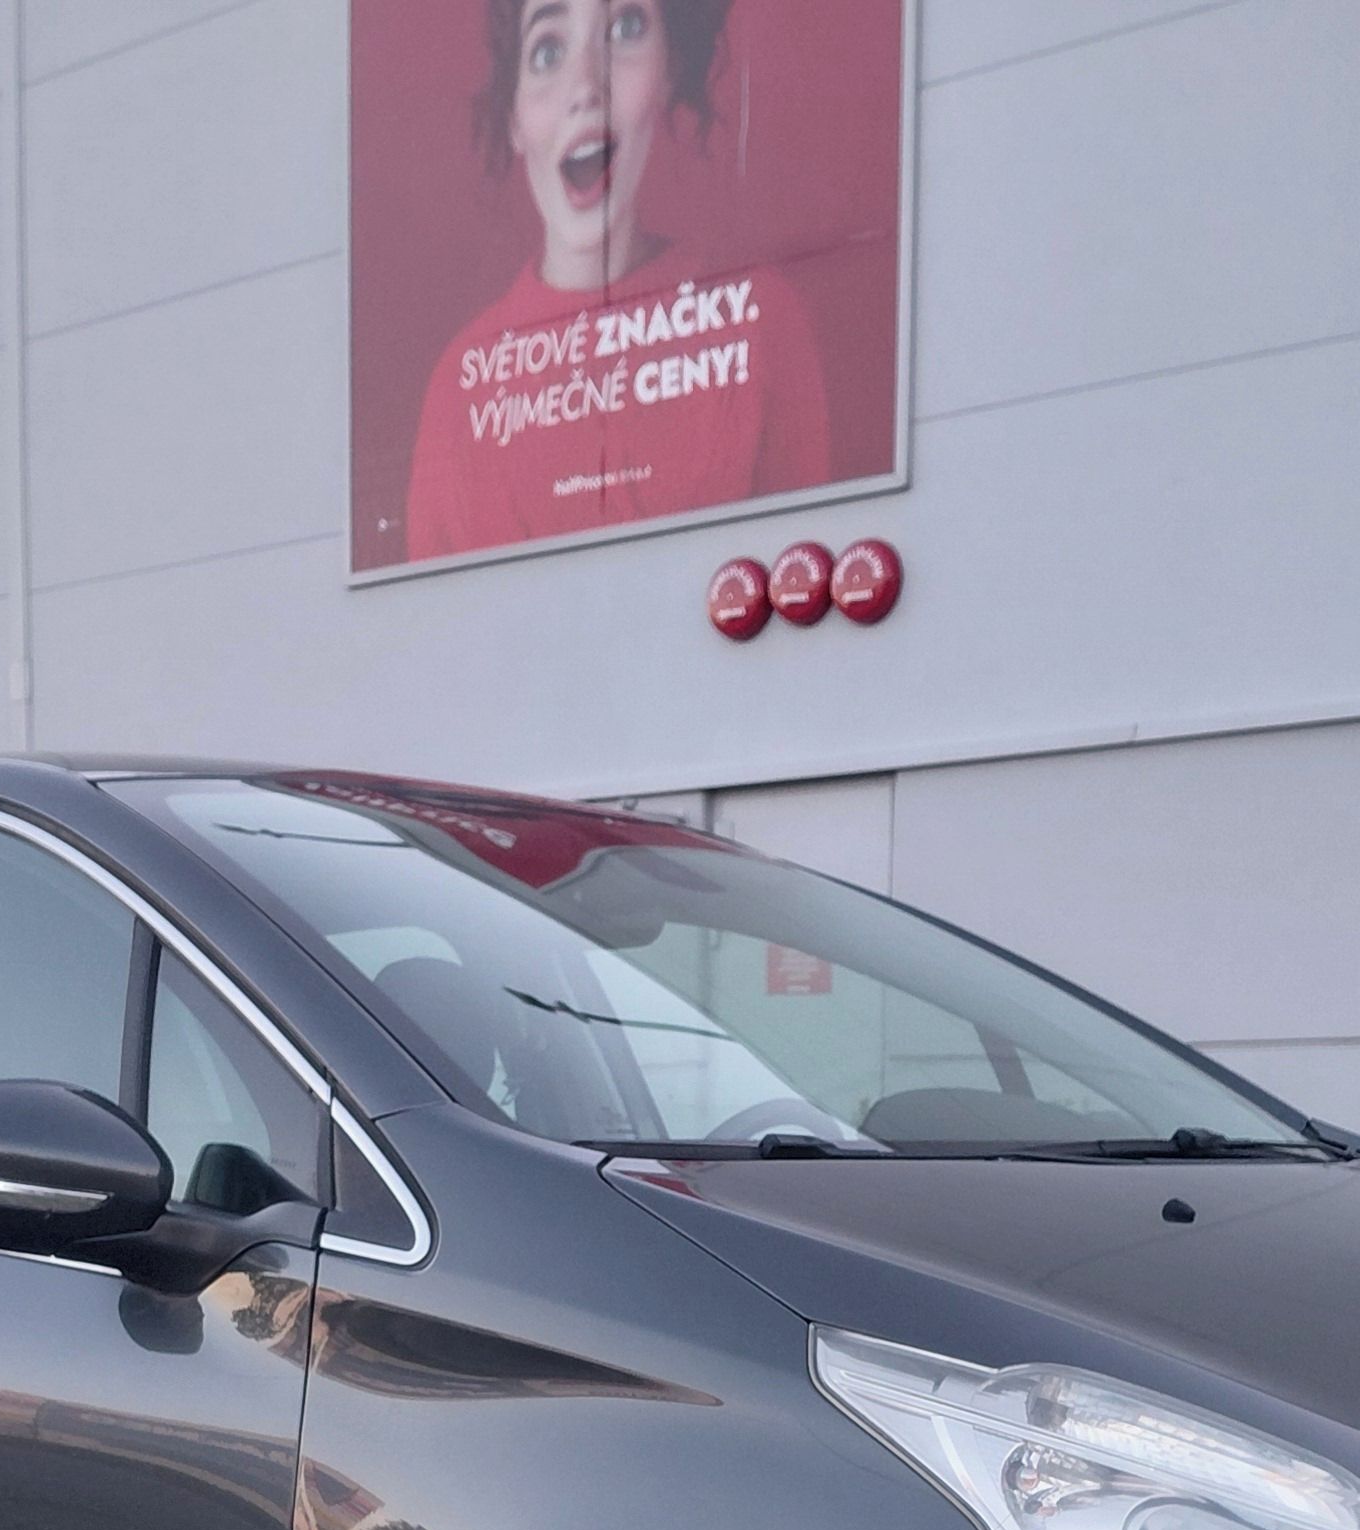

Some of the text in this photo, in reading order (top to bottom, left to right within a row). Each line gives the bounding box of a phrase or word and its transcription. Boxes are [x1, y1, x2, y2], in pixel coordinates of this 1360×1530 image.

[459, 279, 760, 391] SVĚTOVÉ ZNAČKY.
[469, 339, 750, 447] VÝJIMEČNÉ CENY!
